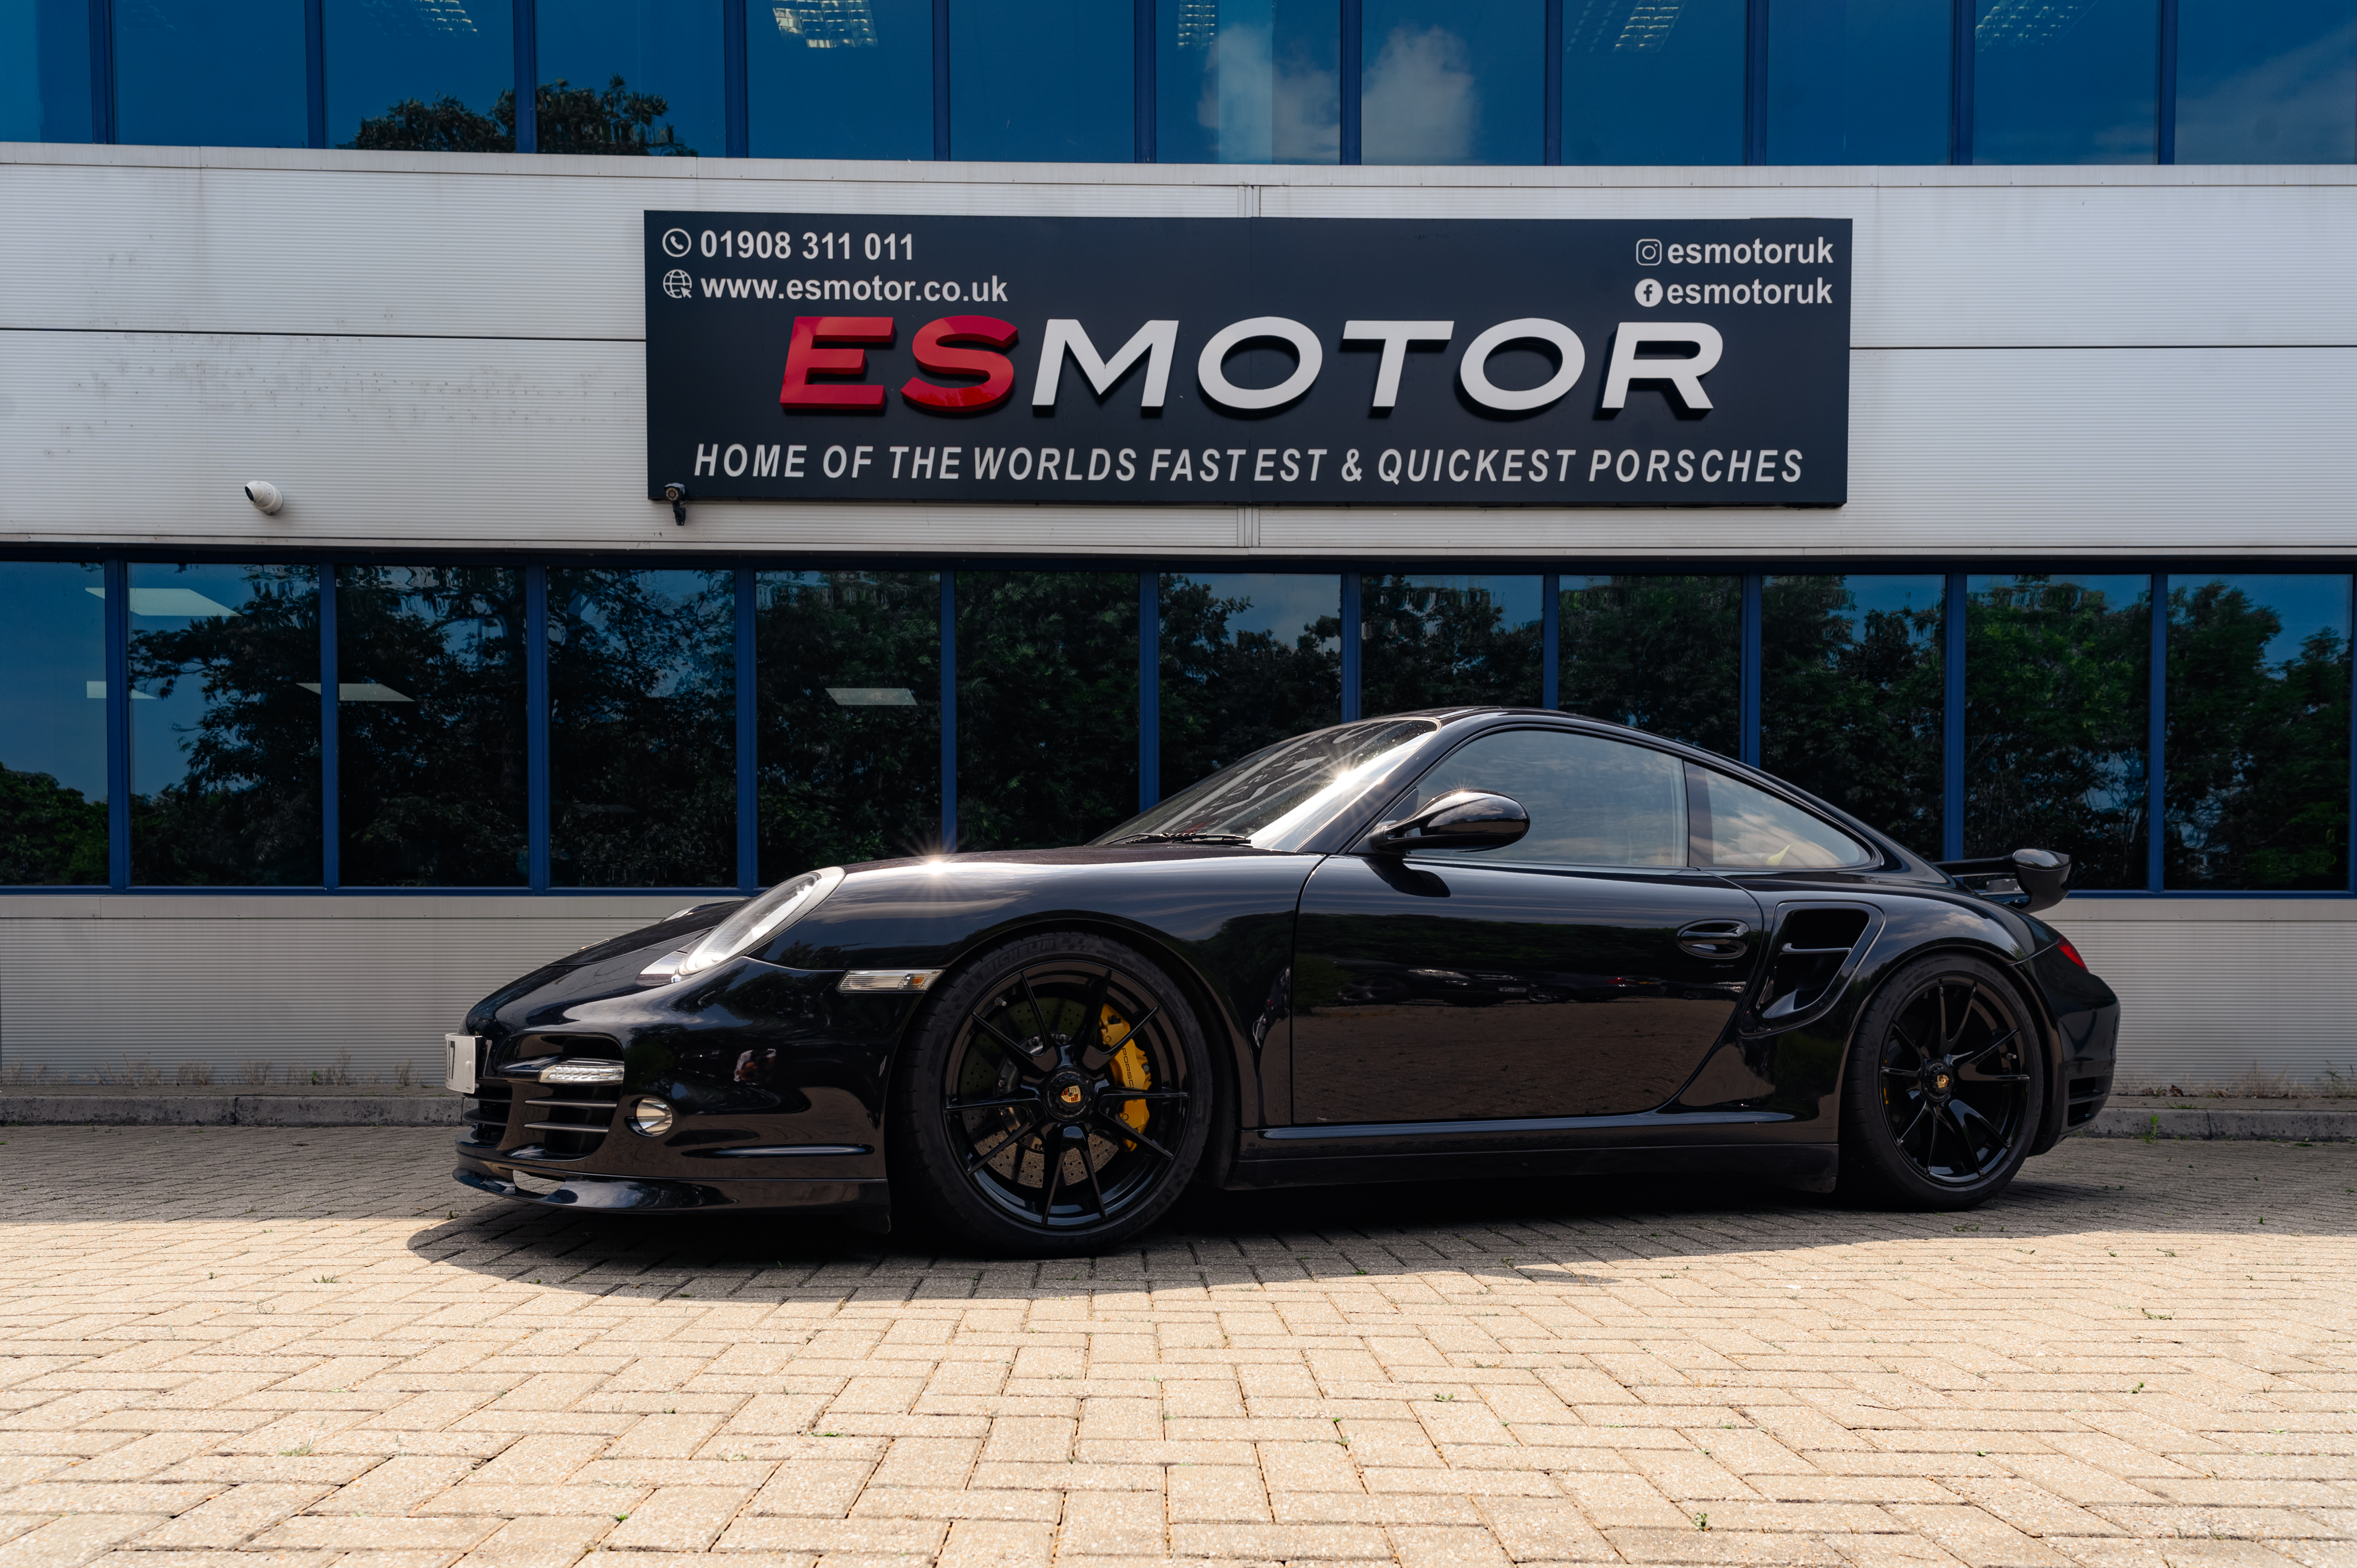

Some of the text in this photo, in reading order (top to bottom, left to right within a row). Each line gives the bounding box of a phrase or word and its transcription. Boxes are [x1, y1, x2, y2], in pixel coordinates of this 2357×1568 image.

[701, 230, 912, 260] 01908 311 011
[1668, 237, 1833, 264] esmotoruk
[701, 275, 1008, 302] www.esmotor.co.uk
[1667, 277, 1832, 304] esmotoruk
[780, 316, 1723, 410] ESMOTOR
[694, 444, 1802, 485] HOME OF THE WORLDS FASTEST & QUICKEST PORSCHES
[980, 940, 1055, 978] MICHELIN
[1122, 1048, 1137, 1102] PORSC
[1087, 1203, 1160, 1247] MICHELIN
